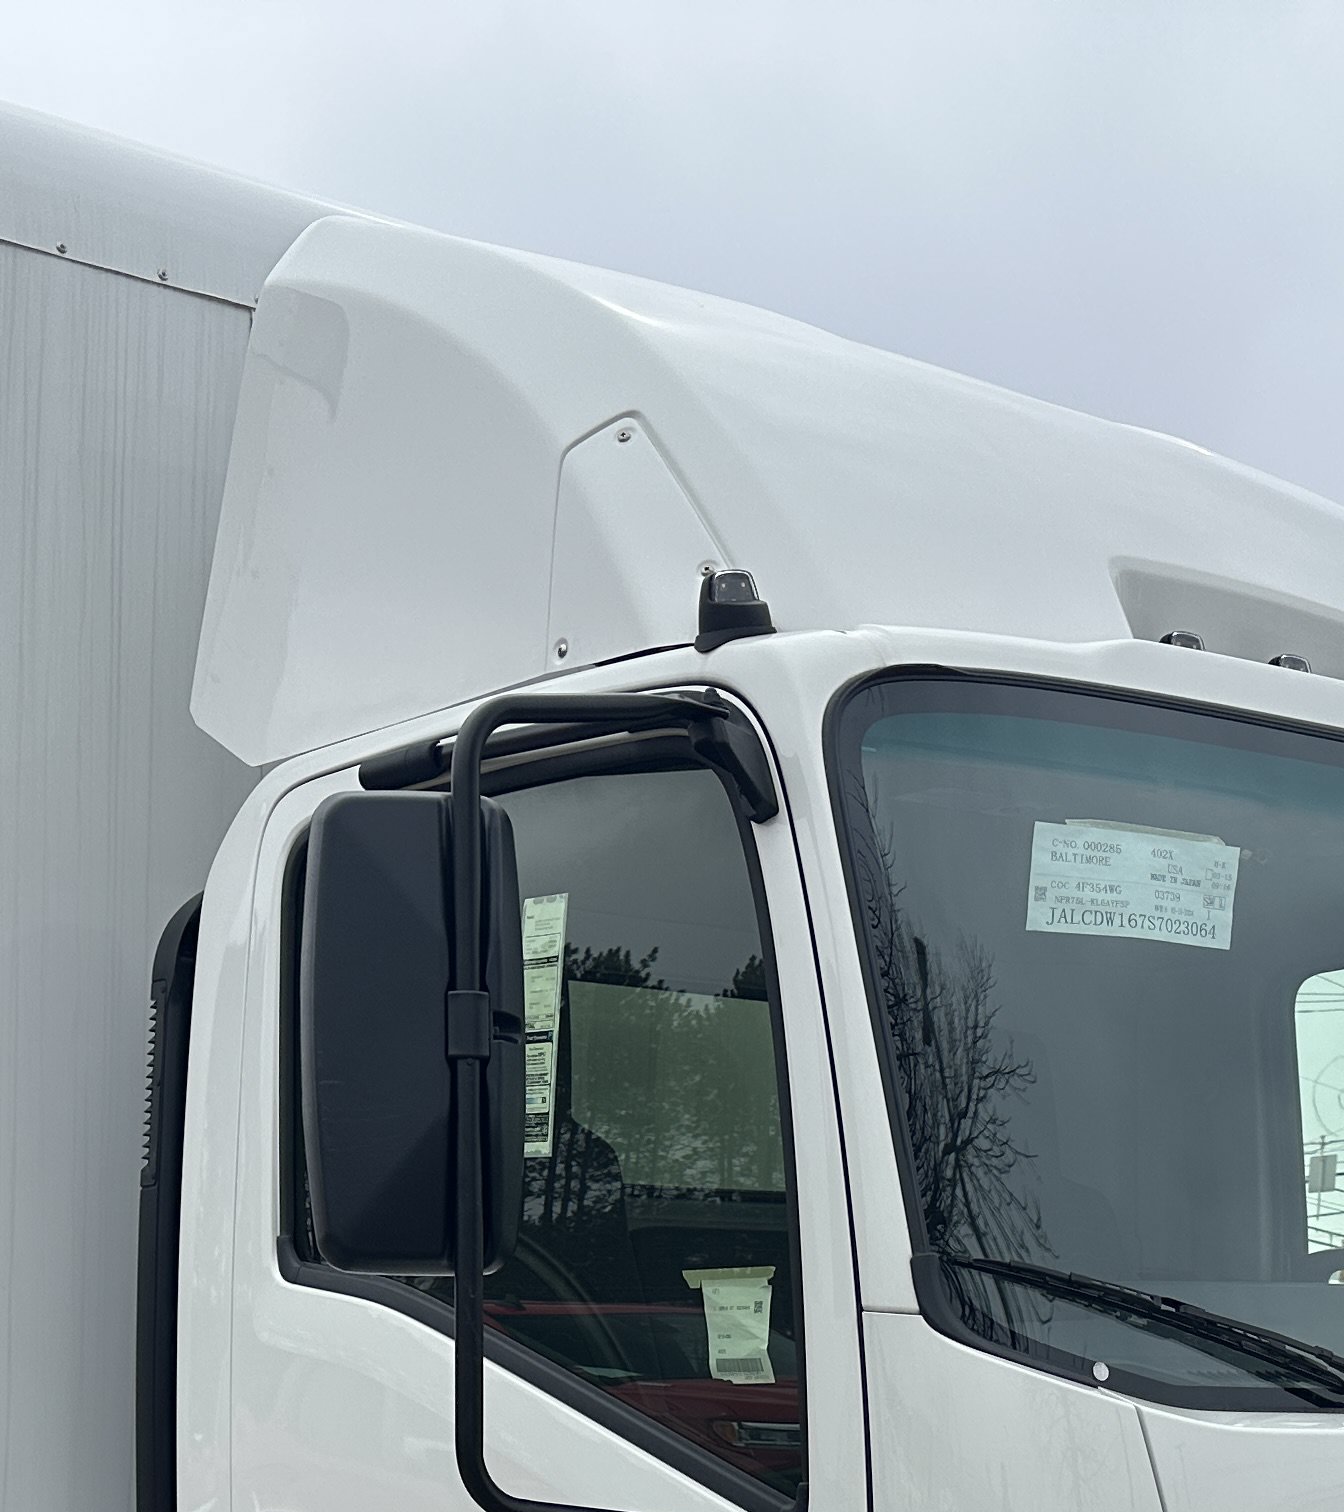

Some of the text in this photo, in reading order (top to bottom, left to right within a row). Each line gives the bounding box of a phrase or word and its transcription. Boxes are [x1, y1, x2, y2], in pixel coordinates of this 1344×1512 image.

[1050, 850, 1112, 867] BALTIMORE
[1150, 847, 1175, 860] 402X
[1045, 906, 1217, 940] JALCDW167S7023064
